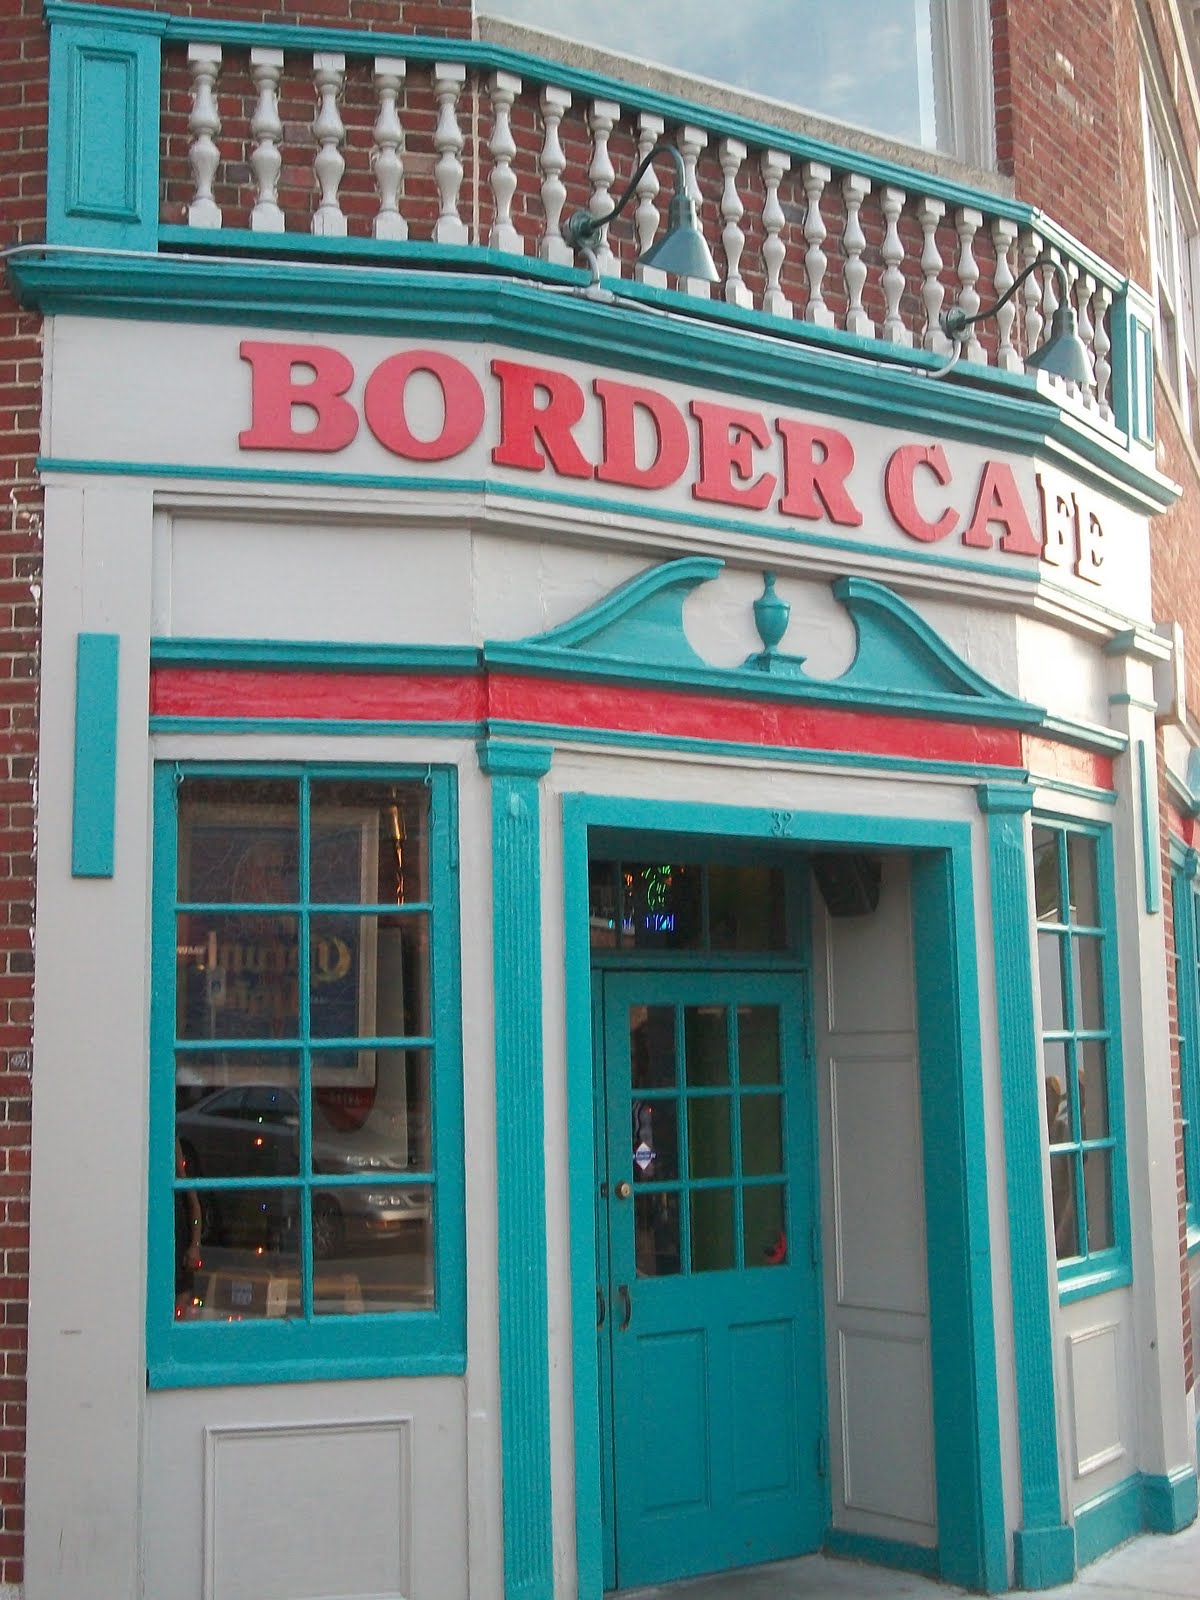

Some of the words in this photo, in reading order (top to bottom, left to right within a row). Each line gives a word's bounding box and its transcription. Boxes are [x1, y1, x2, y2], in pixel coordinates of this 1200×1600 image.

[238, 340, 863, 527] BORDER
[883, 443, 1106, 587] CAFE
[770, 811, 793, 837] 32
